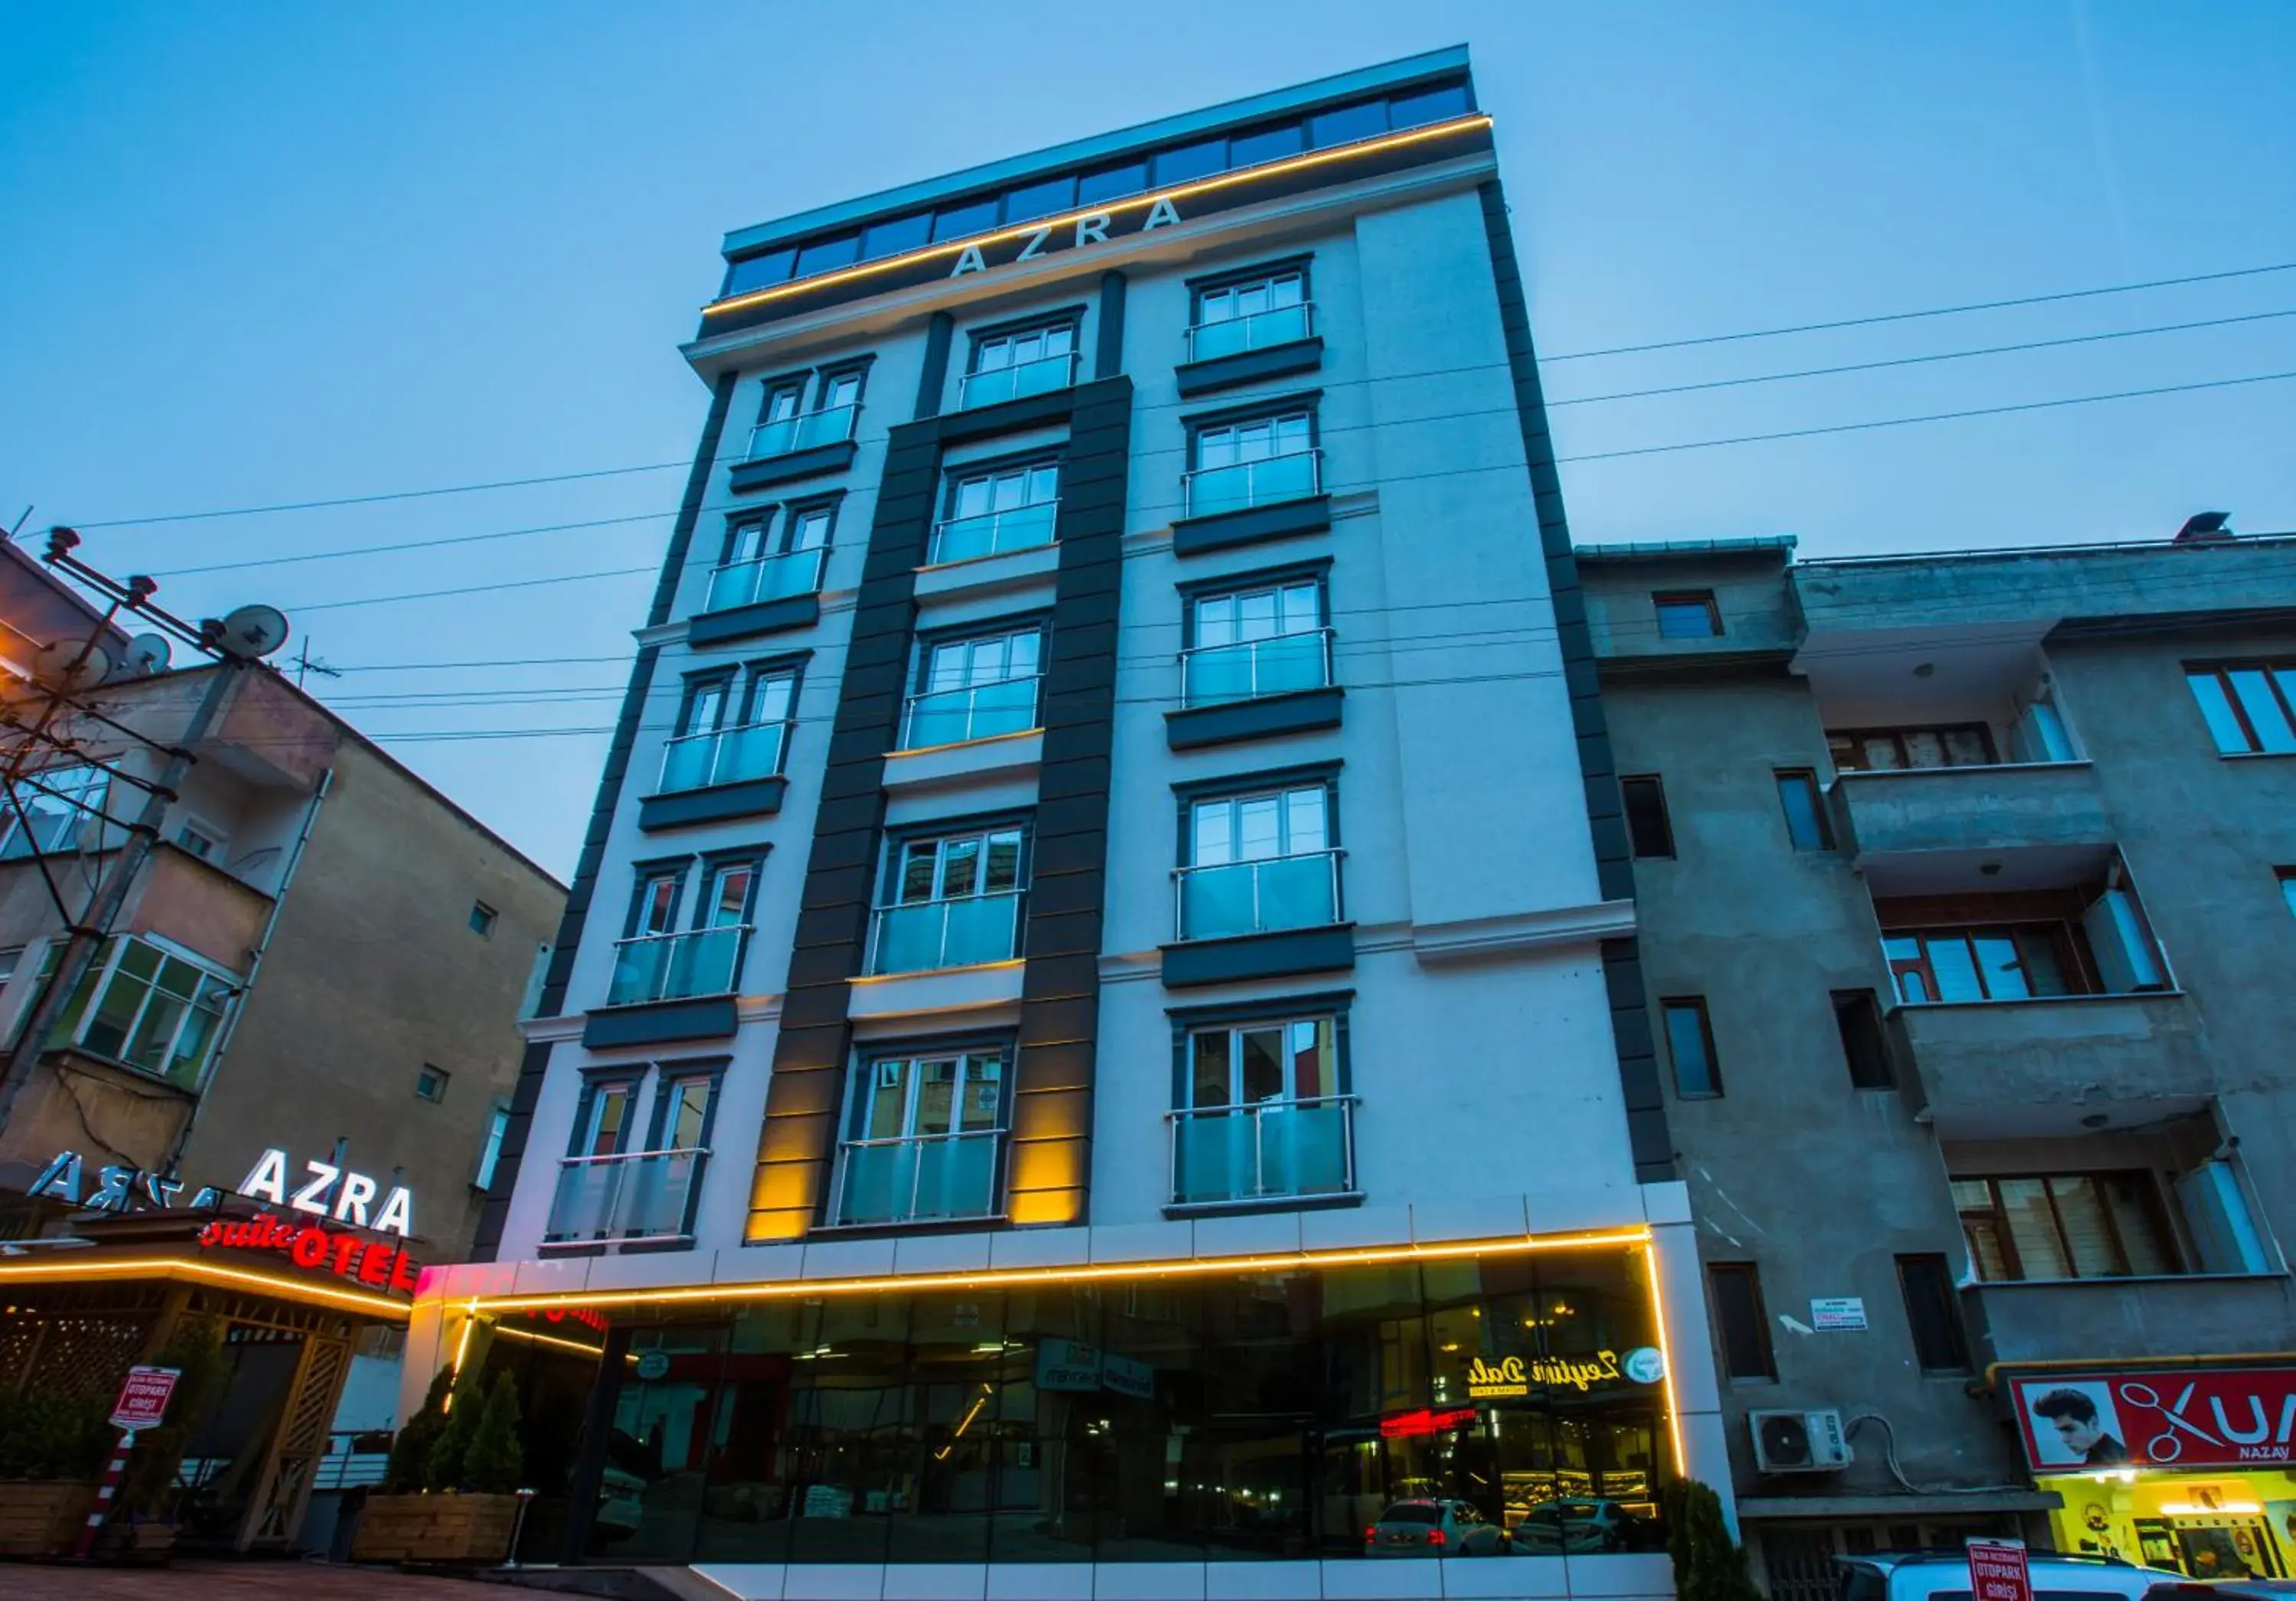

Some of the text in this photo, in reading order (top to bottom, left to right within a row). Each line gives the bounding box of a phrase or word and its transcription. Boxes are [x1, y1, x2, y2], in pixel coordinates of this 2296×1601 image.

[950, 197, 1181, 278] AZRA
[236, 1148, 413, 1237] AZRA
[292, 1227, 417, 1290] OTEL
[1977, 1563, 2022, 1580] OTOPARK
